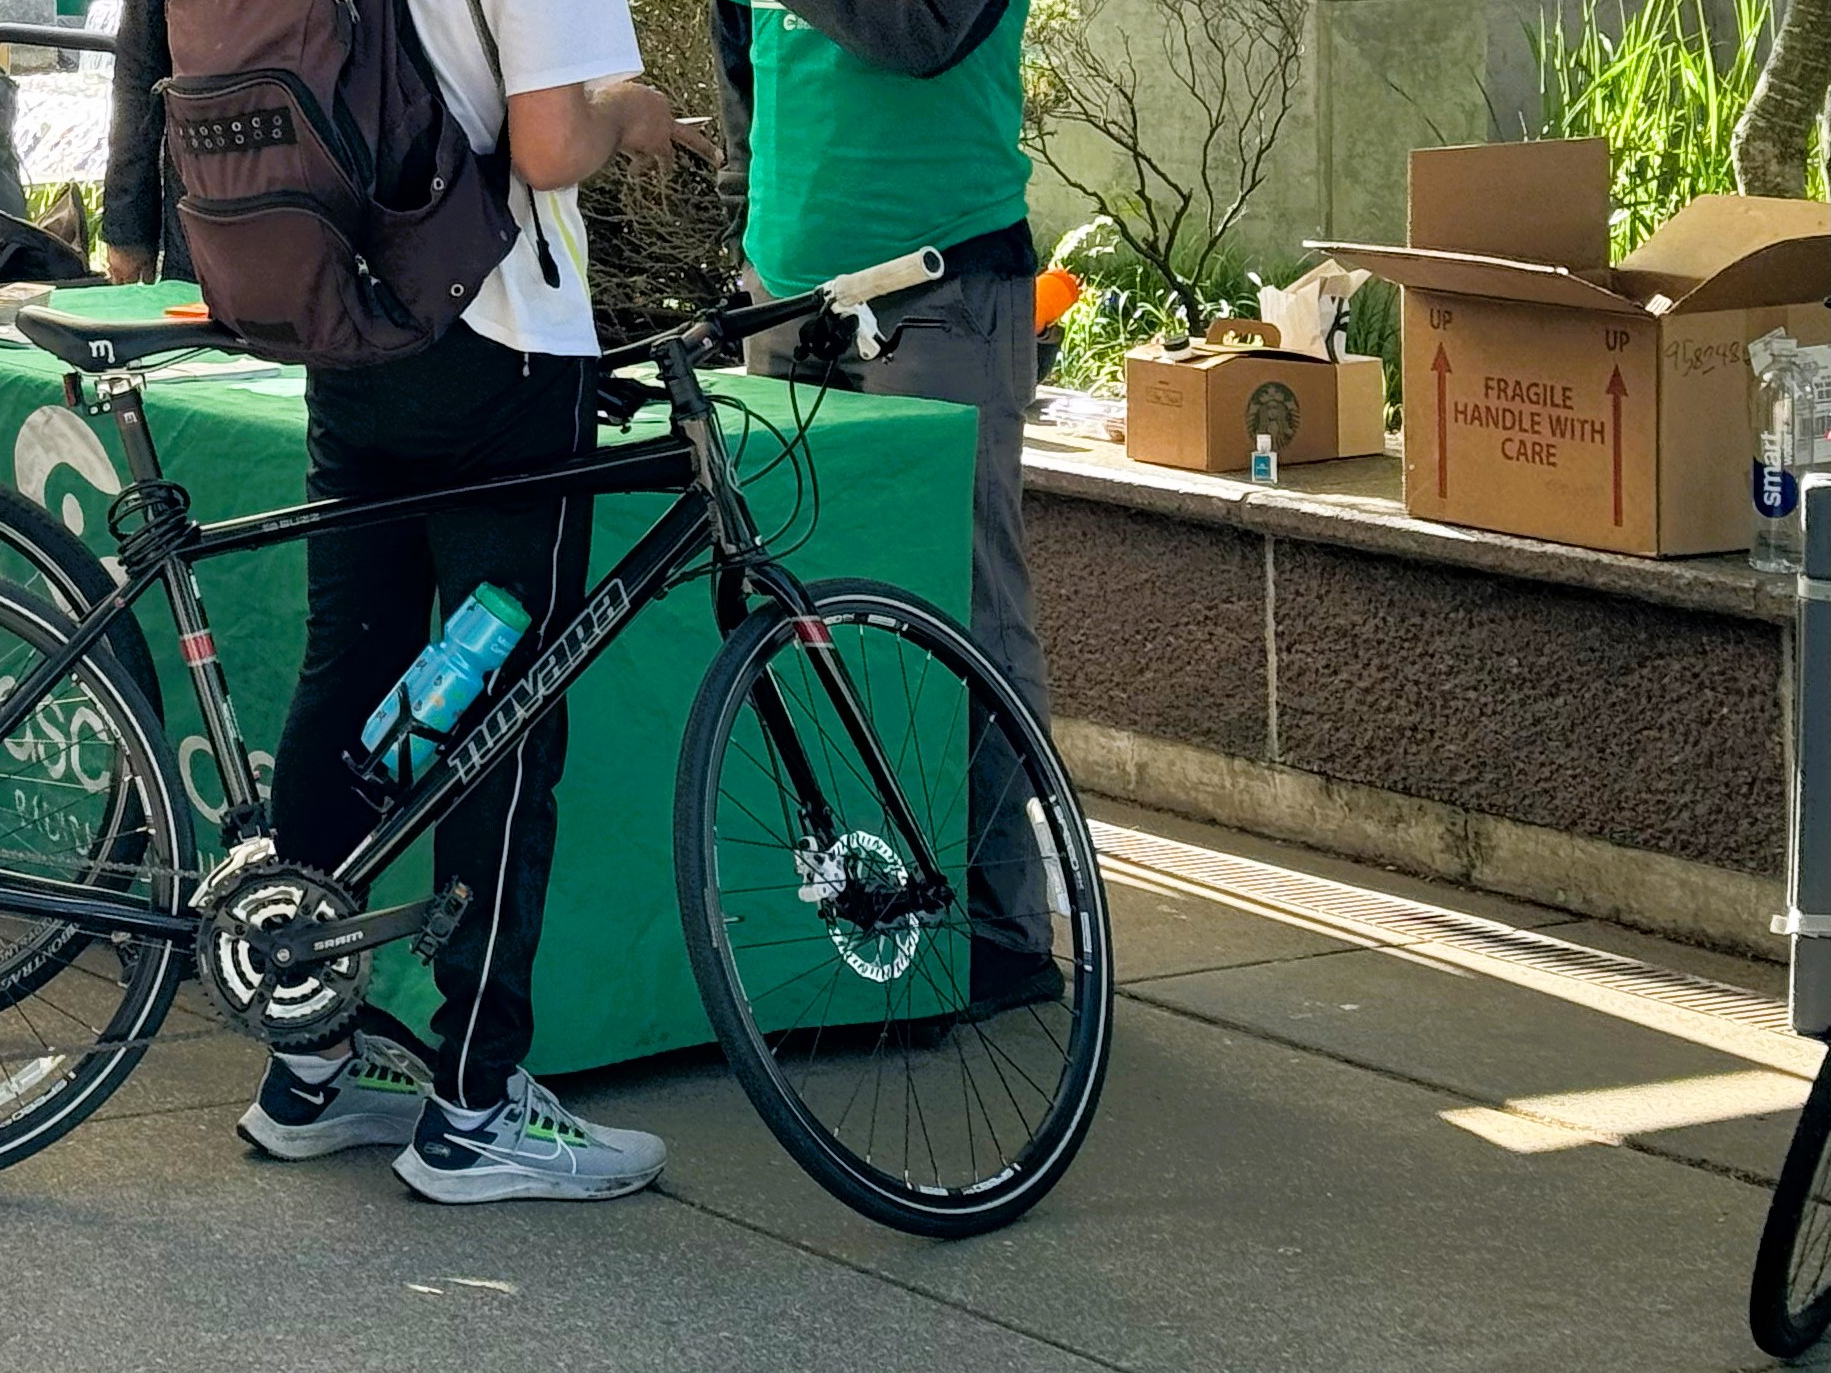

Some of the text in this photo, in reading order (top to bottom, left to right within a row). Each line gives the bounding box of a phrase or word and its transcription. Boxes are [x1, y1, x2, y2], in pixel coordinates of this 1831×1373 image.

[1429, 307, 1453, 331] UP
[1605, 329, 1631, 353] UP
[1483, 376, 1575, 411] FRAGILE
[1453, 400, 1606, 445] HANDLE WITH
[1500, 437, 1559, 468] CARE
[1761, 430, 1783, 507] smart
[314, 930, 364, 951] SRAM
